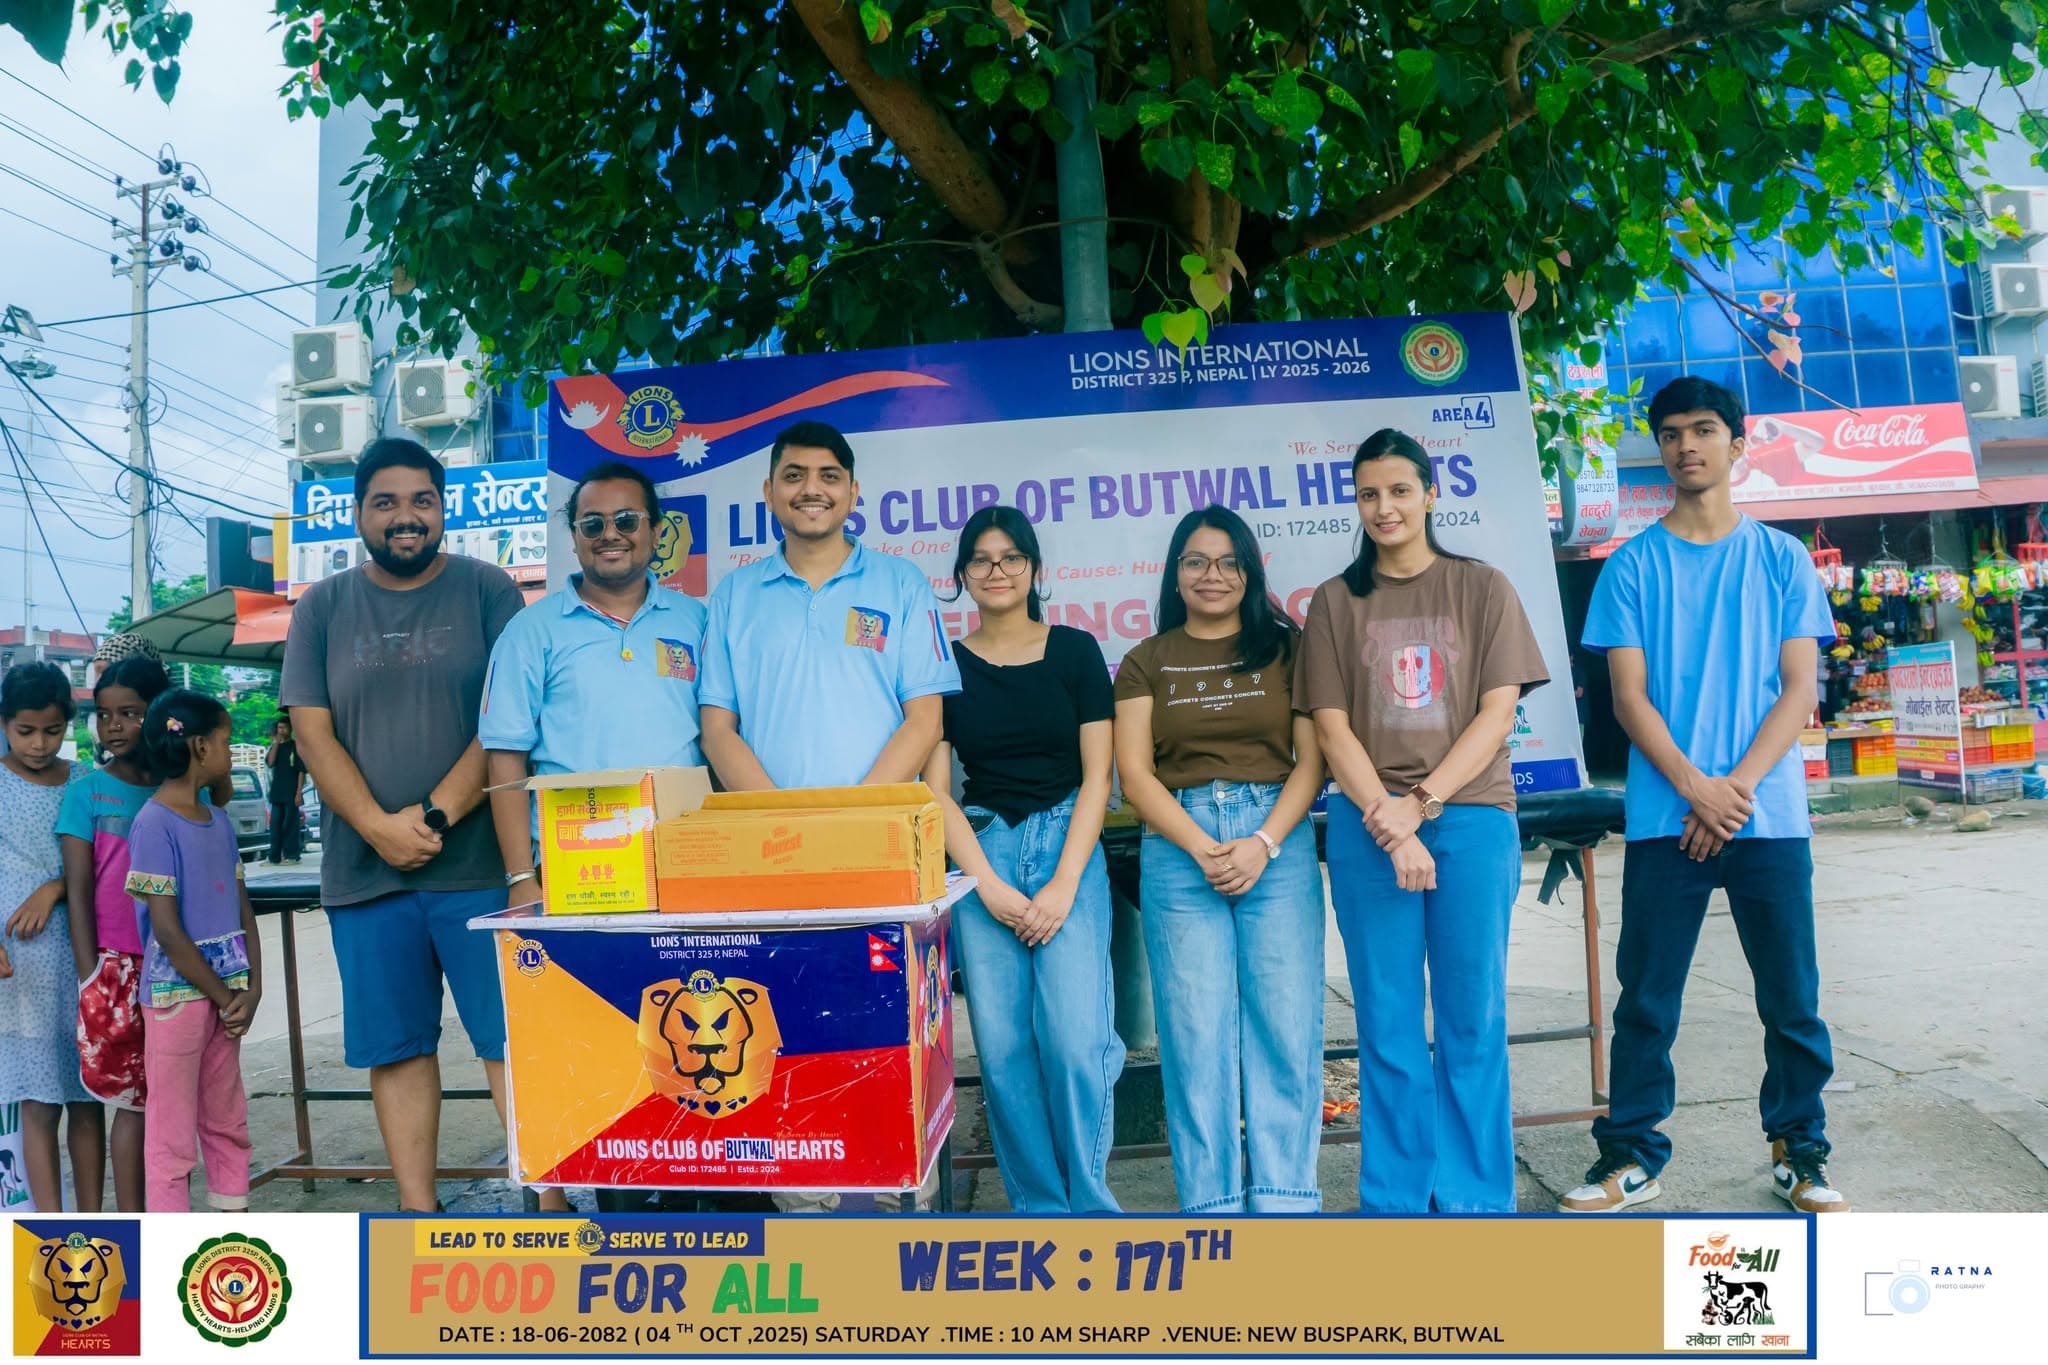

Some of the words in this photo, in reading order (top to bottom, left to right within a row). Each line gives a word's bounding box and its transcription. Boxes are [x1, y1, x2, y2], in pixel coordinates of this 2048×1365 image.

[1069, 349, 1150, 373] LIONS
[1158, 337, 1368, 368] INTERNATIONAL
[1071, 373, 1144, 390] DISTRICT
[1148, 371, 1177, 385] 325
[1197, 366, 1248, 382] NEPAL
[1260, 365, 1278, 379] LY
[1281, 363, 1320, 377] 2025
[1332, 361, 1371, 375] 2026
[631, 387, 670, 402] LIONS
[643, 405, 661, 427] L
[1432, 407, 1474, 423] AREA
[1475, 401, 1491, 424] 4
[1833, 413, 1928, 449] Coca-Cola
[473, 470, 547, 517] सेन्टर
[1015, 478, 1075, 524] OF
[1089, 466, 1286, 520] BUTWAL
[1296, 454, 1478, 507] HETS
[1257, 522, 1282, 539] ID:
[1287, 518, 1352, 537] 172485
[1435, 510, 1481, 528] 2024
[1056, 566, 1124, 581] Cause:
[1167, 697, 1199, 706] CONCRETE
[1200, 694, 1232, 702] CONCRETE
[1234, 690, 1265, 698] CONCRETE
[587, 787, 597, 819] FOODS
[518, 940, 543, 951] LIONS
[651, 935, 680, 948] LIONS
[684, 934, 762, 947] INTERNATIONAL
[526, 951, 537, 965] L
[659, 950, 695, 960] DISTRICT
[698, 949, 713, 959] 325
[722, 948, 748, 958] NEPAL
[700, 980, 709, 991] L
[597, 1139, 649, 1159] LIONS
[652, 1139, 698, 1160] CLUB
[701, 1140, 724, 1160] OF
[725, 1139, 775, 1160] BUTWAL
[774, 1139, 846, 1160] HEARTS
[669, 1165, 687, 1173] Club
[688, 1165, 699, 1173] ID:
[700, 1165, 727, 1173] 172485
[760, 1165, 780, 1173] 2024
